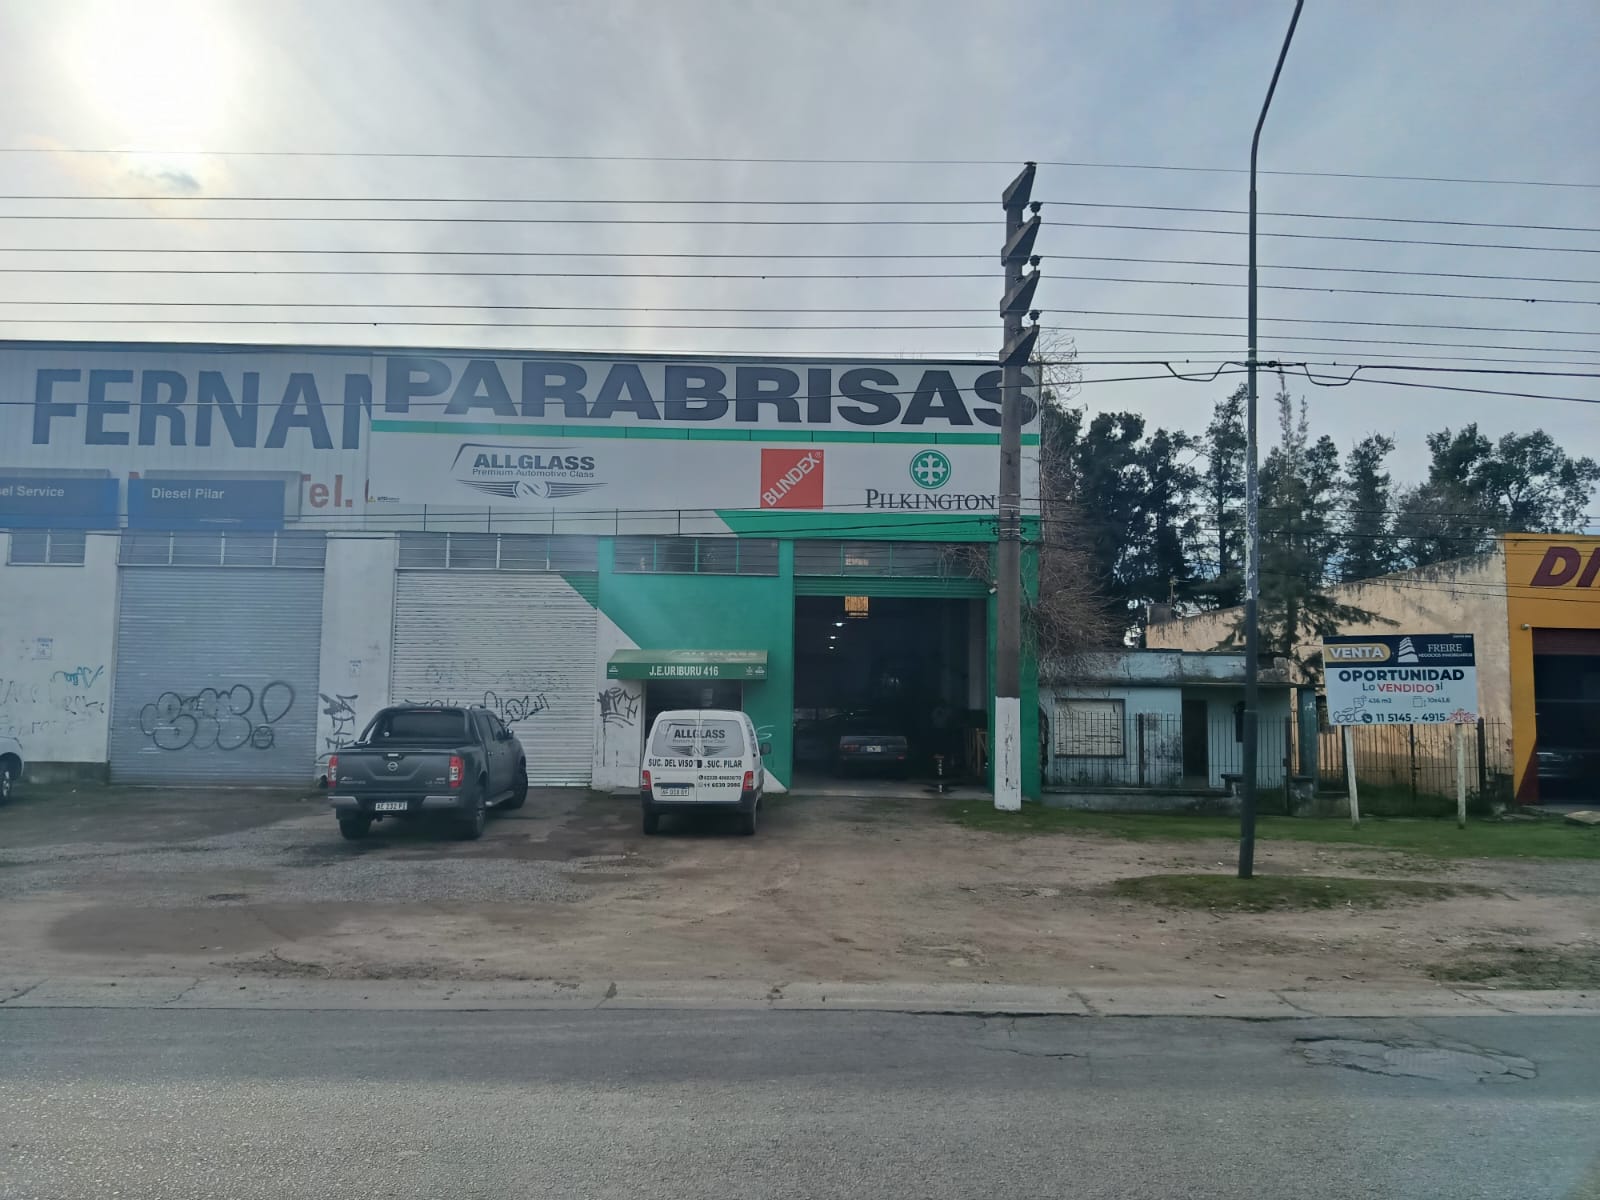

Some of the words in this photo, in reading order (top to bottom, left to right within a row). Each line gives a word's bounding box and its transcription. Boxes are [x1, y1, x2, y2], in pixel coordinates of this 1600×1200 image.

[385, 356, 1038, 428] PARABRISAS
[473, 453, 596, 471] ALLGLASS
[472, 468, 513, 477] Premium
[515, 469, 567, 478] Automotive
[762, 452, 820, 506] BLINDEX
[17, 485, 65, 498] Service
[151, 487, 191, 499] Diesel
[195, 488, 225, 500] Pilar
[865, 489, 995, 511] PILKINGTON
[1330, 646, 1384, 659] VENTA
[1428, 643, 1463, 653] FREIRE
[649, 666, 701, 676] J.E.URIBURU
[703, 666, 719, 676] 416
[1338, 669, 1465, 682] OPORTUNIDAD
[1378, 683, 1435, 693] VENDIDO
[1376, 714, 1385, 722] 11
[1388, 713, 1411, 722] 5145
[1422, 713, 1446, 722] 4915
[664, 759, 677, 768] DEL
[678, 759, 694, 768] VISO
[723, 760, 743, 768] PILAR
